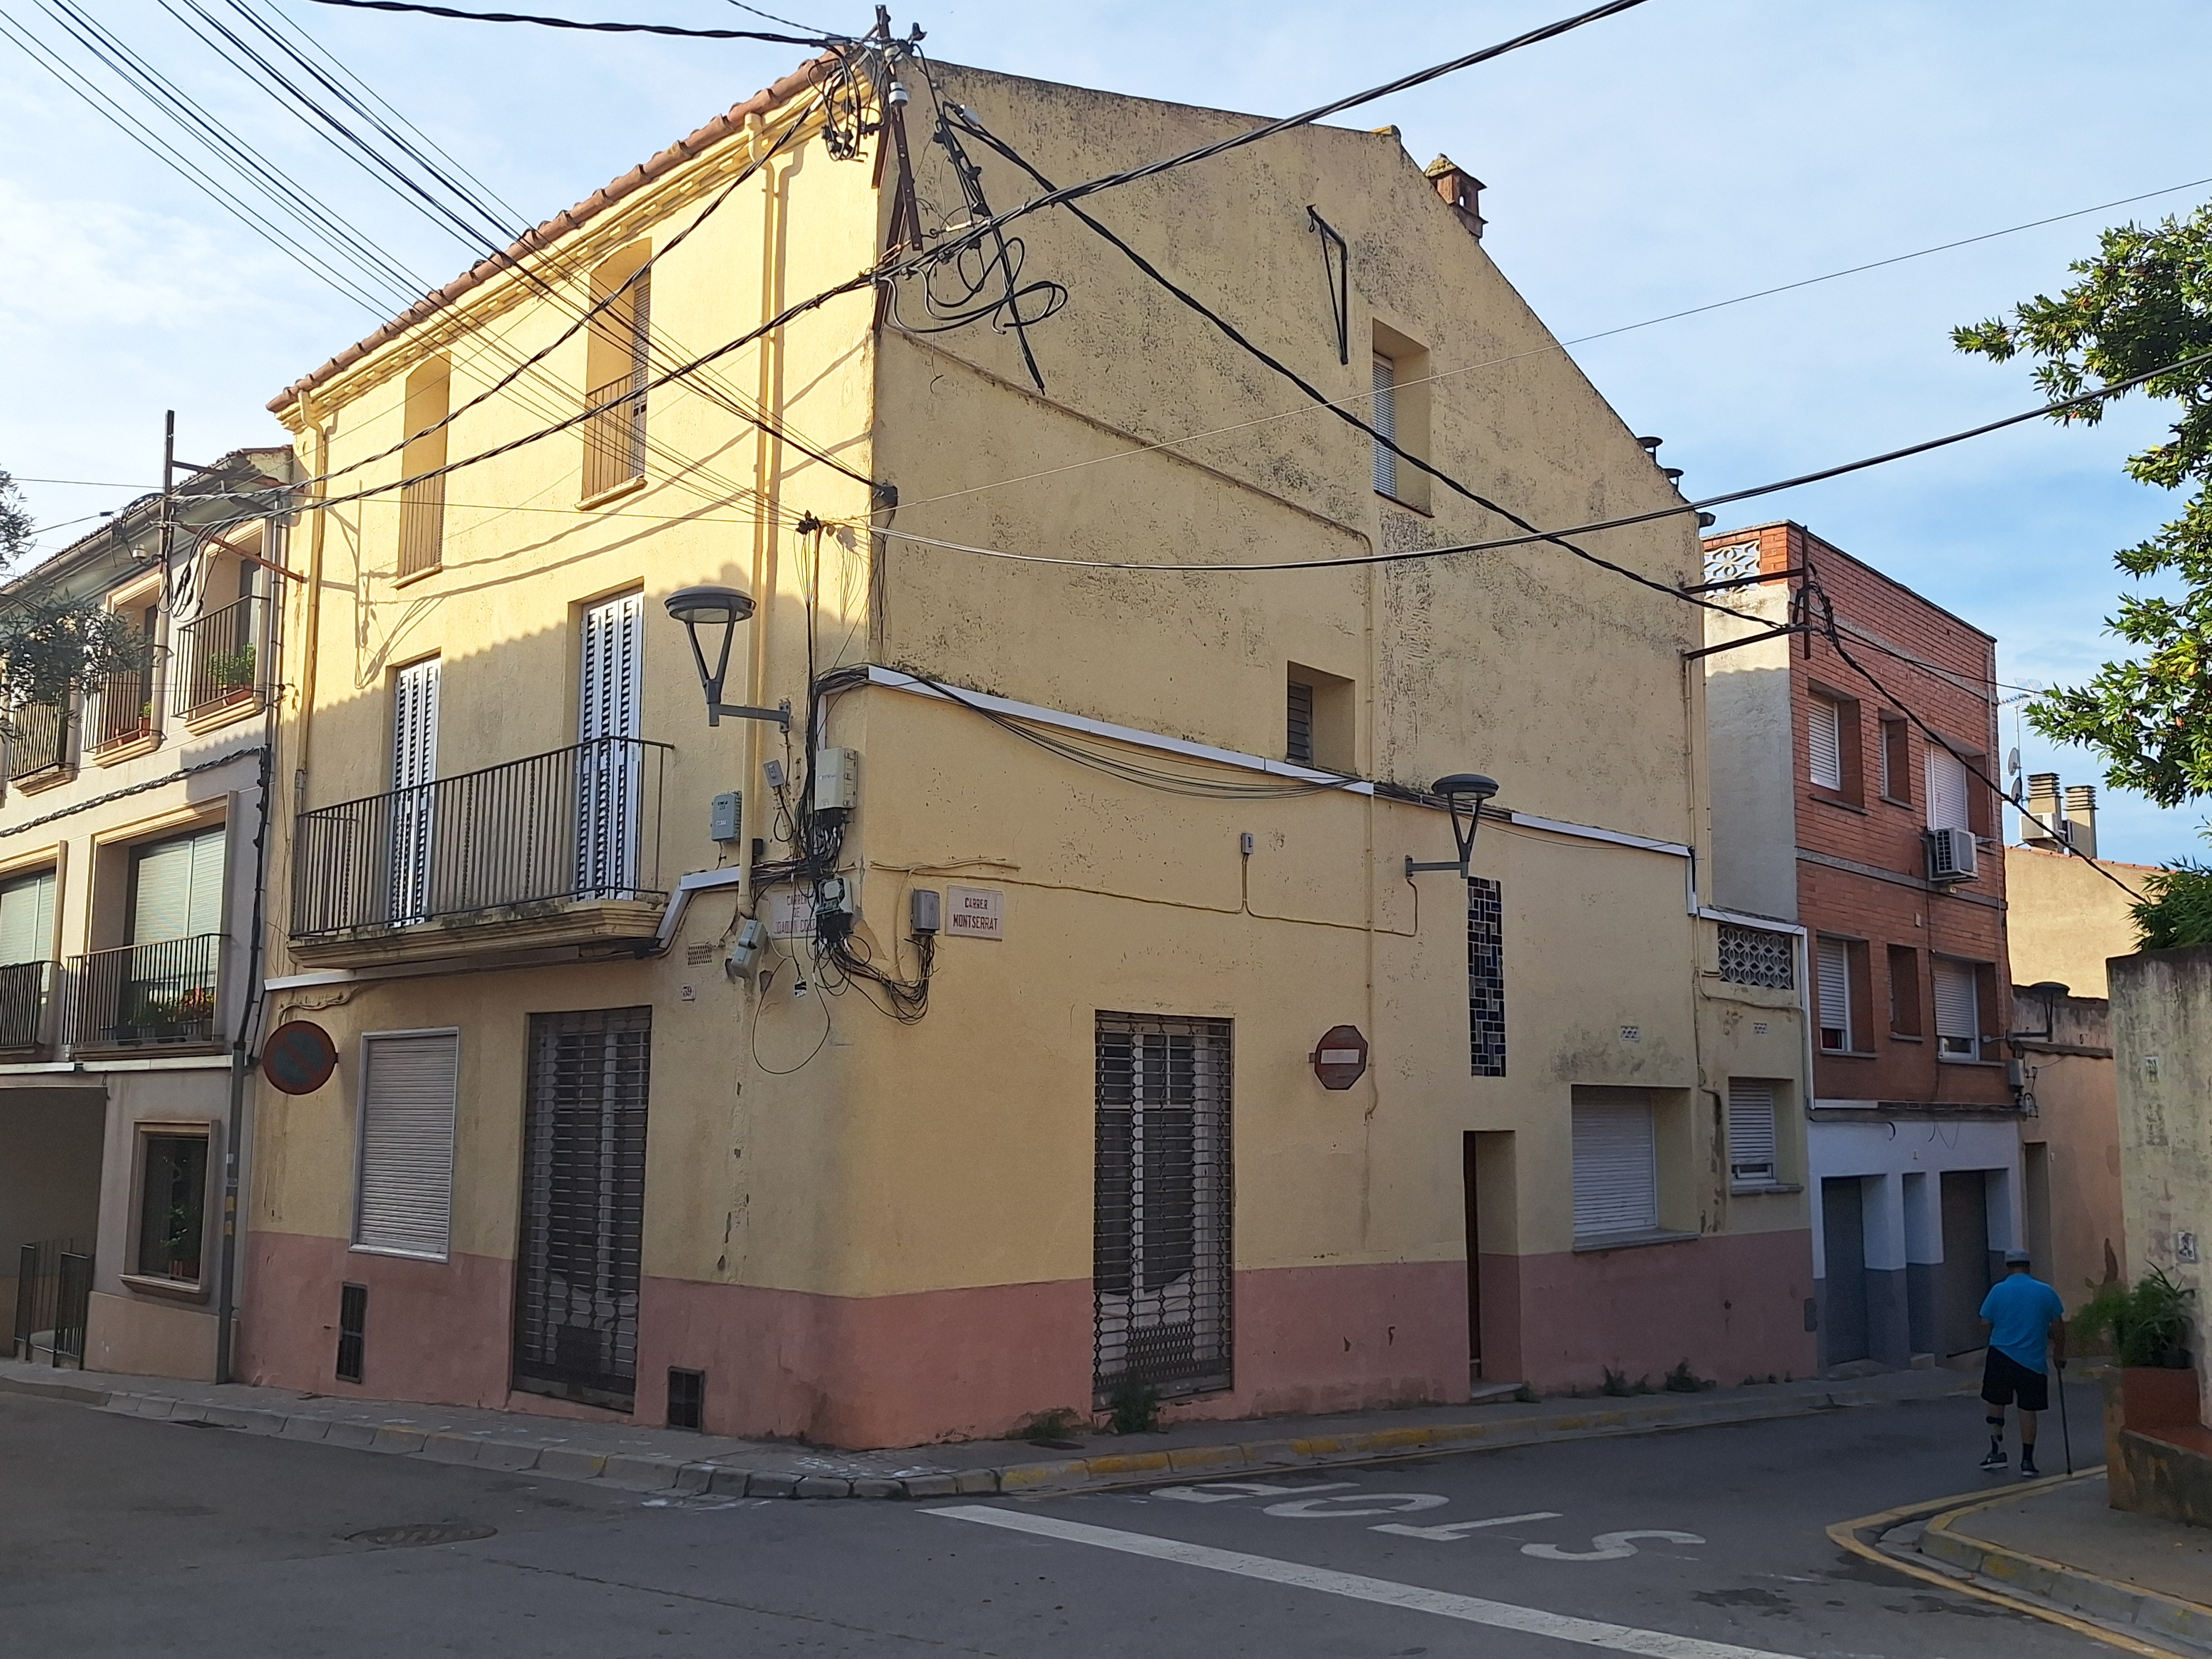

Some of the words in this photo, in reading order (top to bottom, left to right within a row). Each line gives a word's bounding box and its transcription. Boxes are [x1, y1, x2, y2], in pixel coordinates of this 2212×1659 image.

[787, 893, 807, 906] CARRER
[964, 897, 988, 910] CARRER
[793, 907, 800, 918] DE
[774, 921, 798, 935] JOAQUN
[800, 918, 816, 933] COT
[953, 914, 999, 931] MONTSERRAT
[1149, 1482, 1706, 1561] STOP
